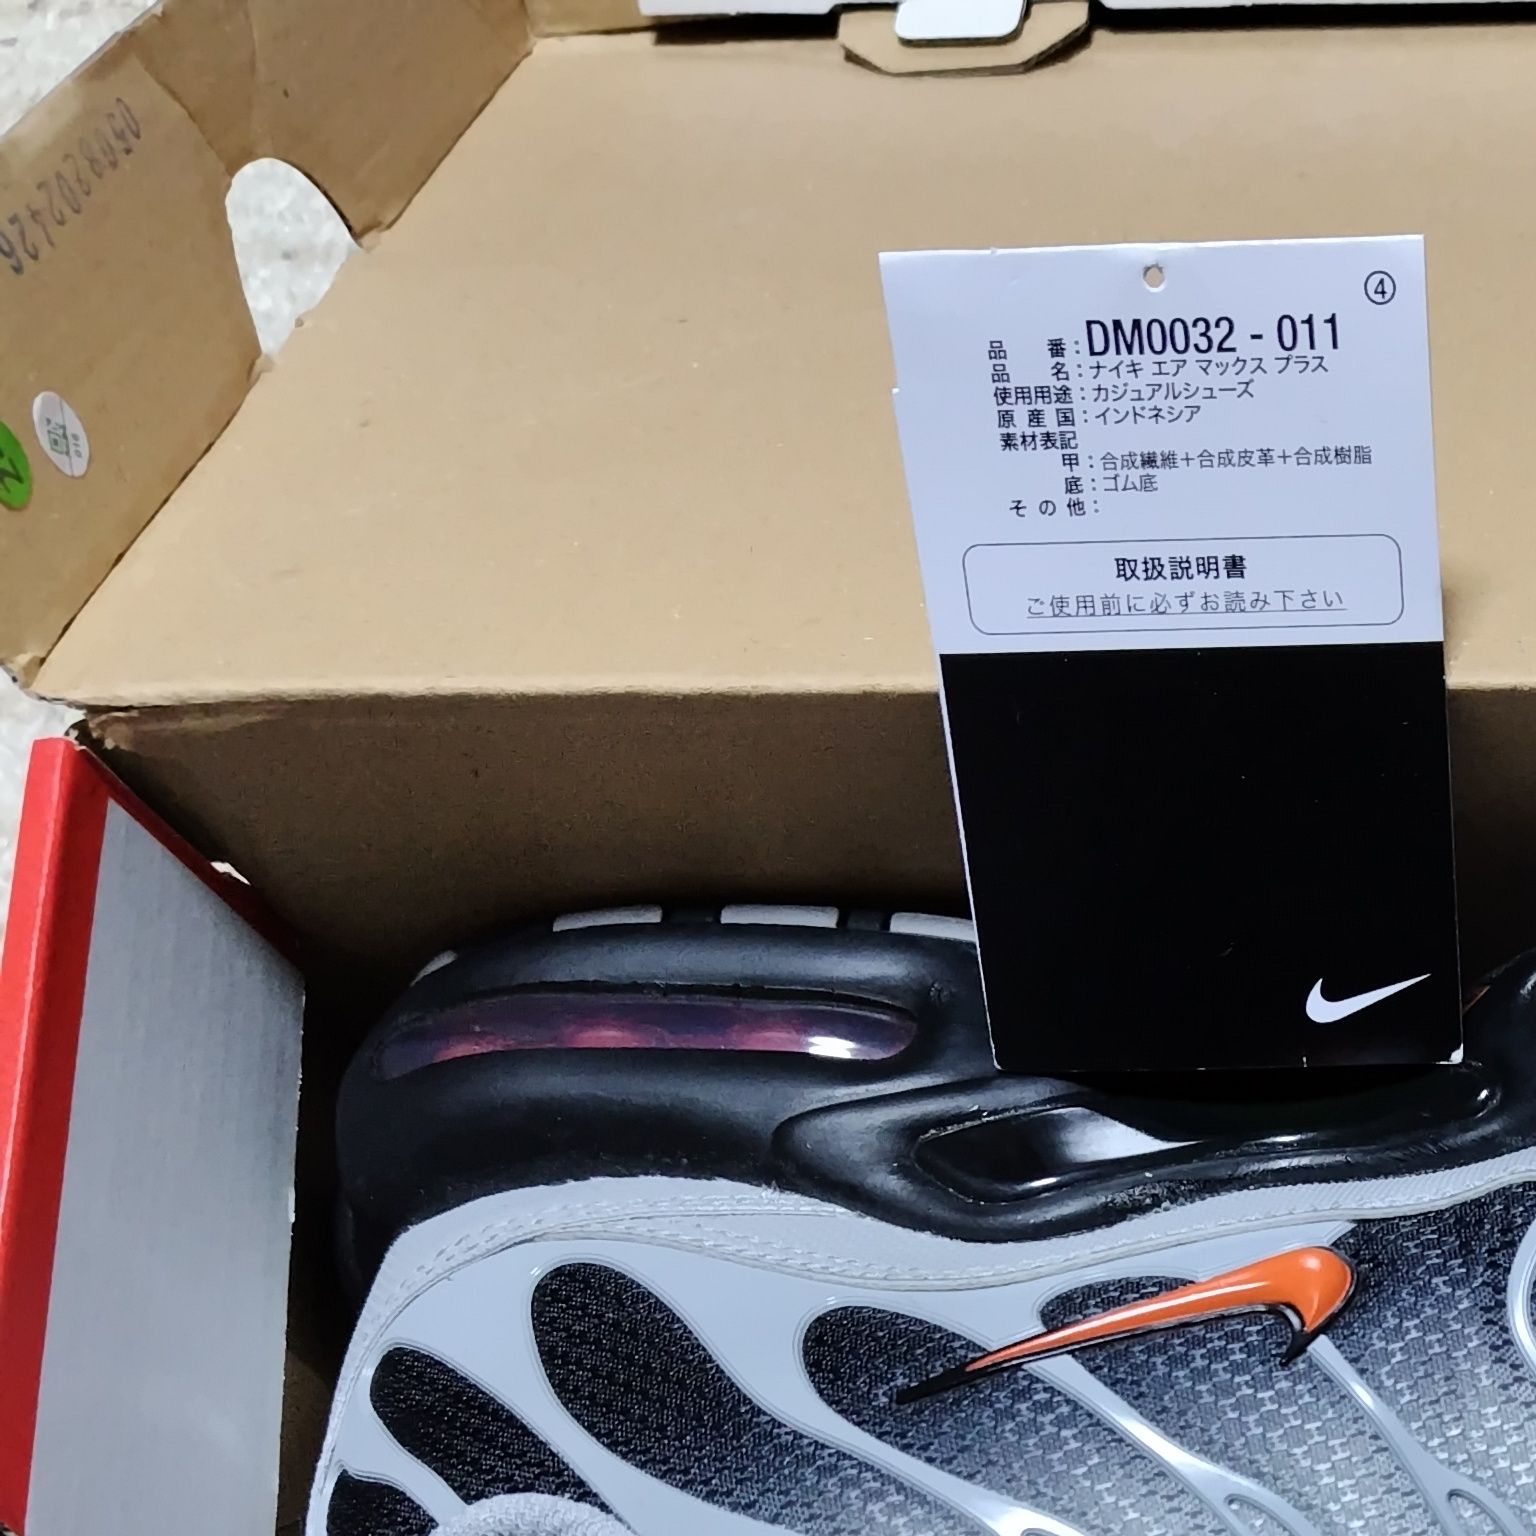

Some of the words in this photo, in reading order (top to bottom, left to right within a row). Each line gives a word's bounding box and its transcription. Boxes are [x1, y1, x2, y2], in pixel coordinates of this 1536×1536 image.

[1000, 430, 1079, 451] 素材表記
[1114, 553, 1248, 581] 取扱説明書
[1027, 588, 1344, 618] ご使用前に必ずお読み下さい
